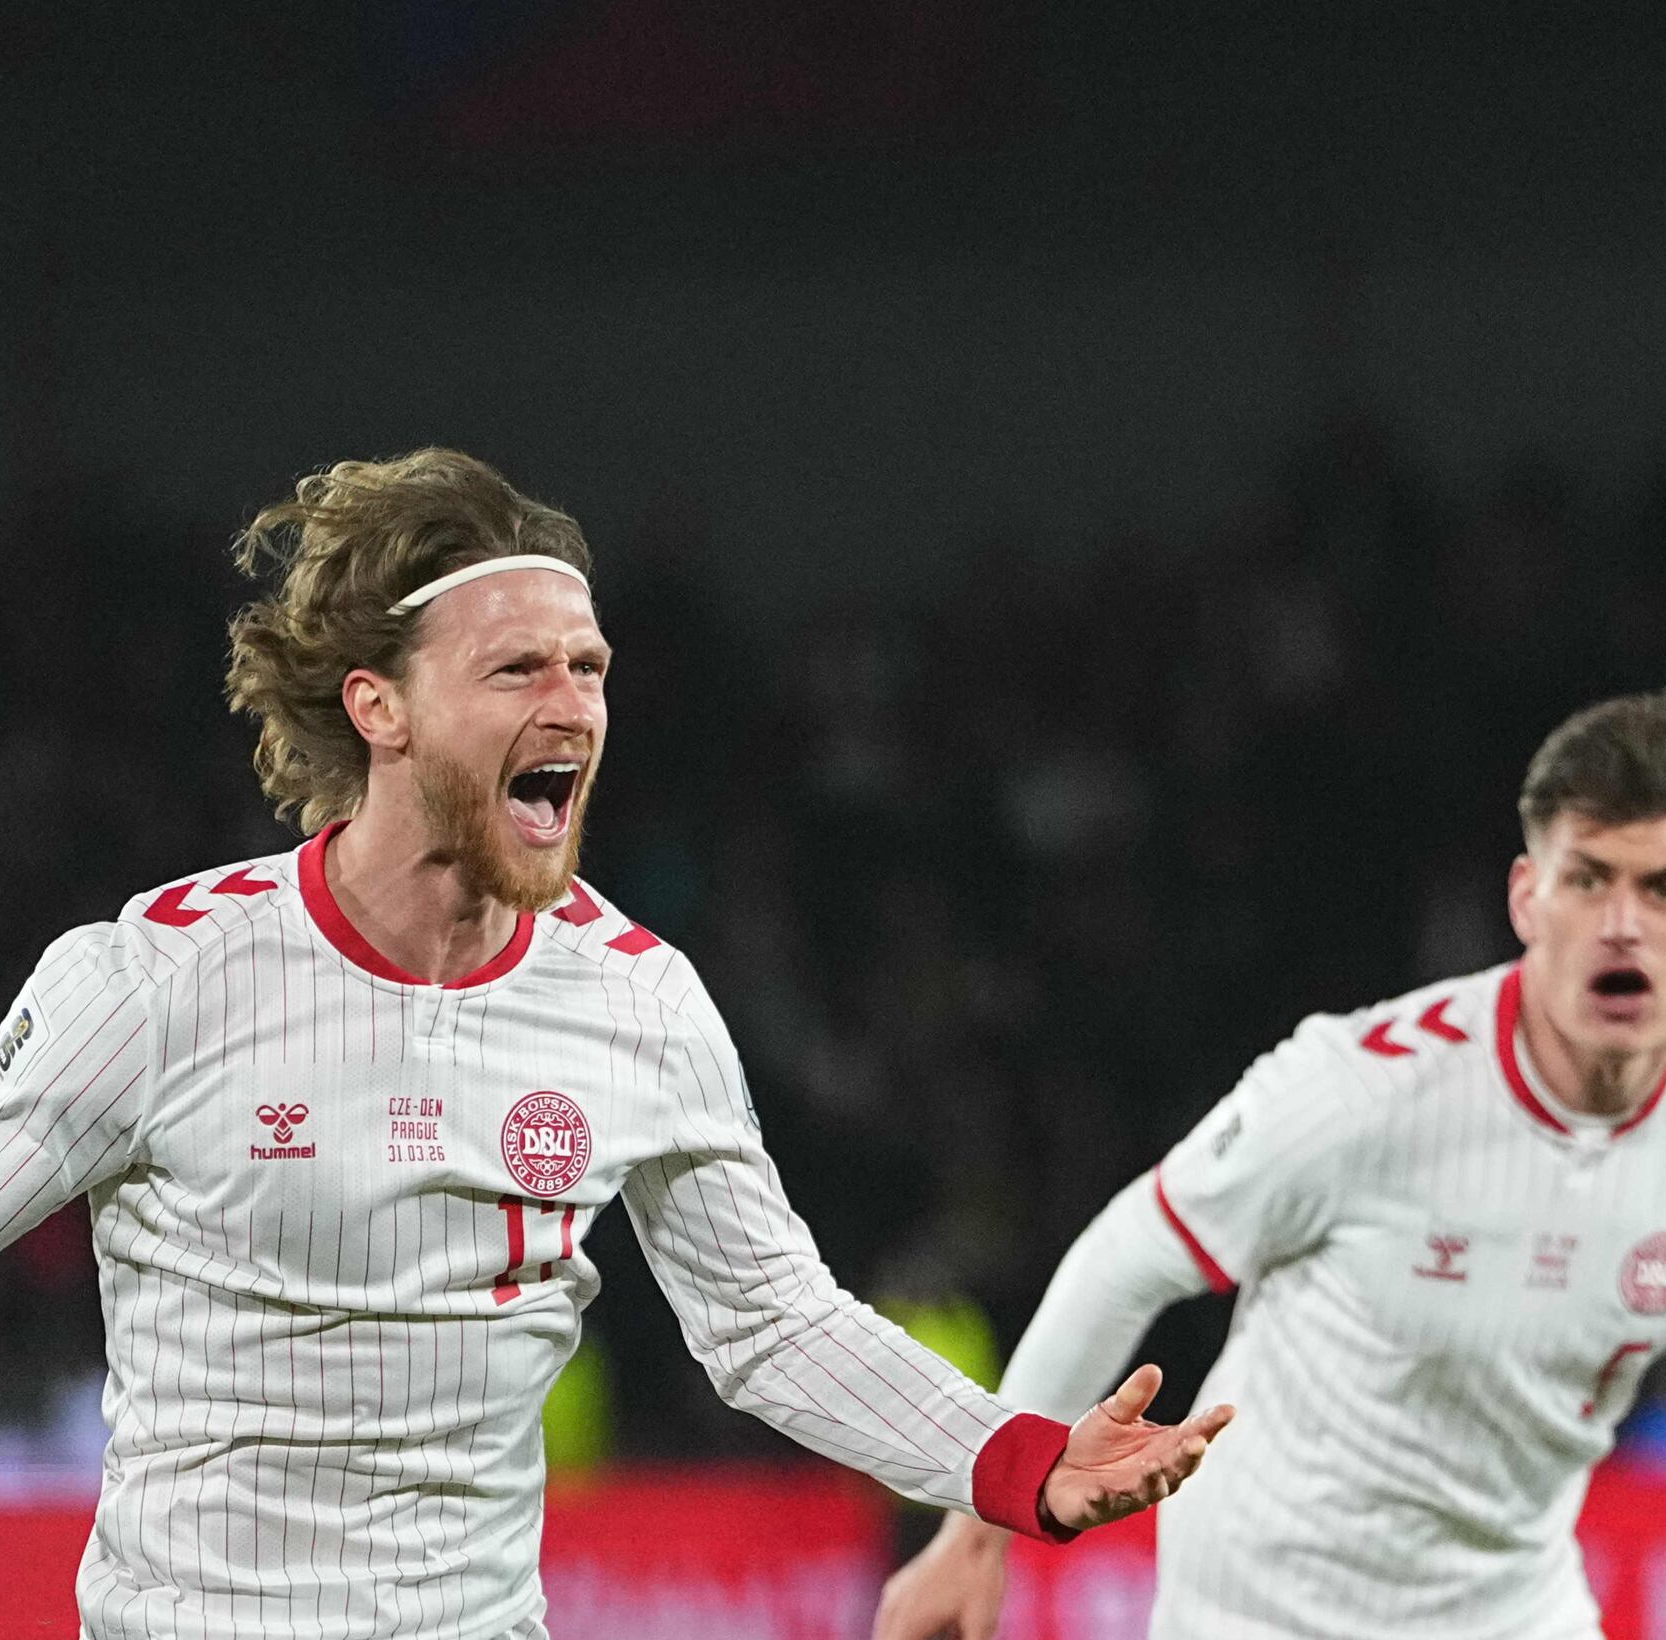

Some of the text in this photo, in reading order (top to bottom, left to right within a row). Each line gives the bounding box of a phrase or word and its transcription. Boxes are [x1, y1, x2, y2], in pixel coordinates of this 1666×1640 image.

[391, 1121, 438, 1140] PRAGUE
[507, 1121, 528, 1178] DANSK
[566, 1127, 587, 1179] UNION
[522, 1126, 573, 1157] DBU
[250, 1142, 316, 1160] hummel
[388, 1145, 445, 1162] 31.03.26
[529, 1176, 564, 1191] 1889
